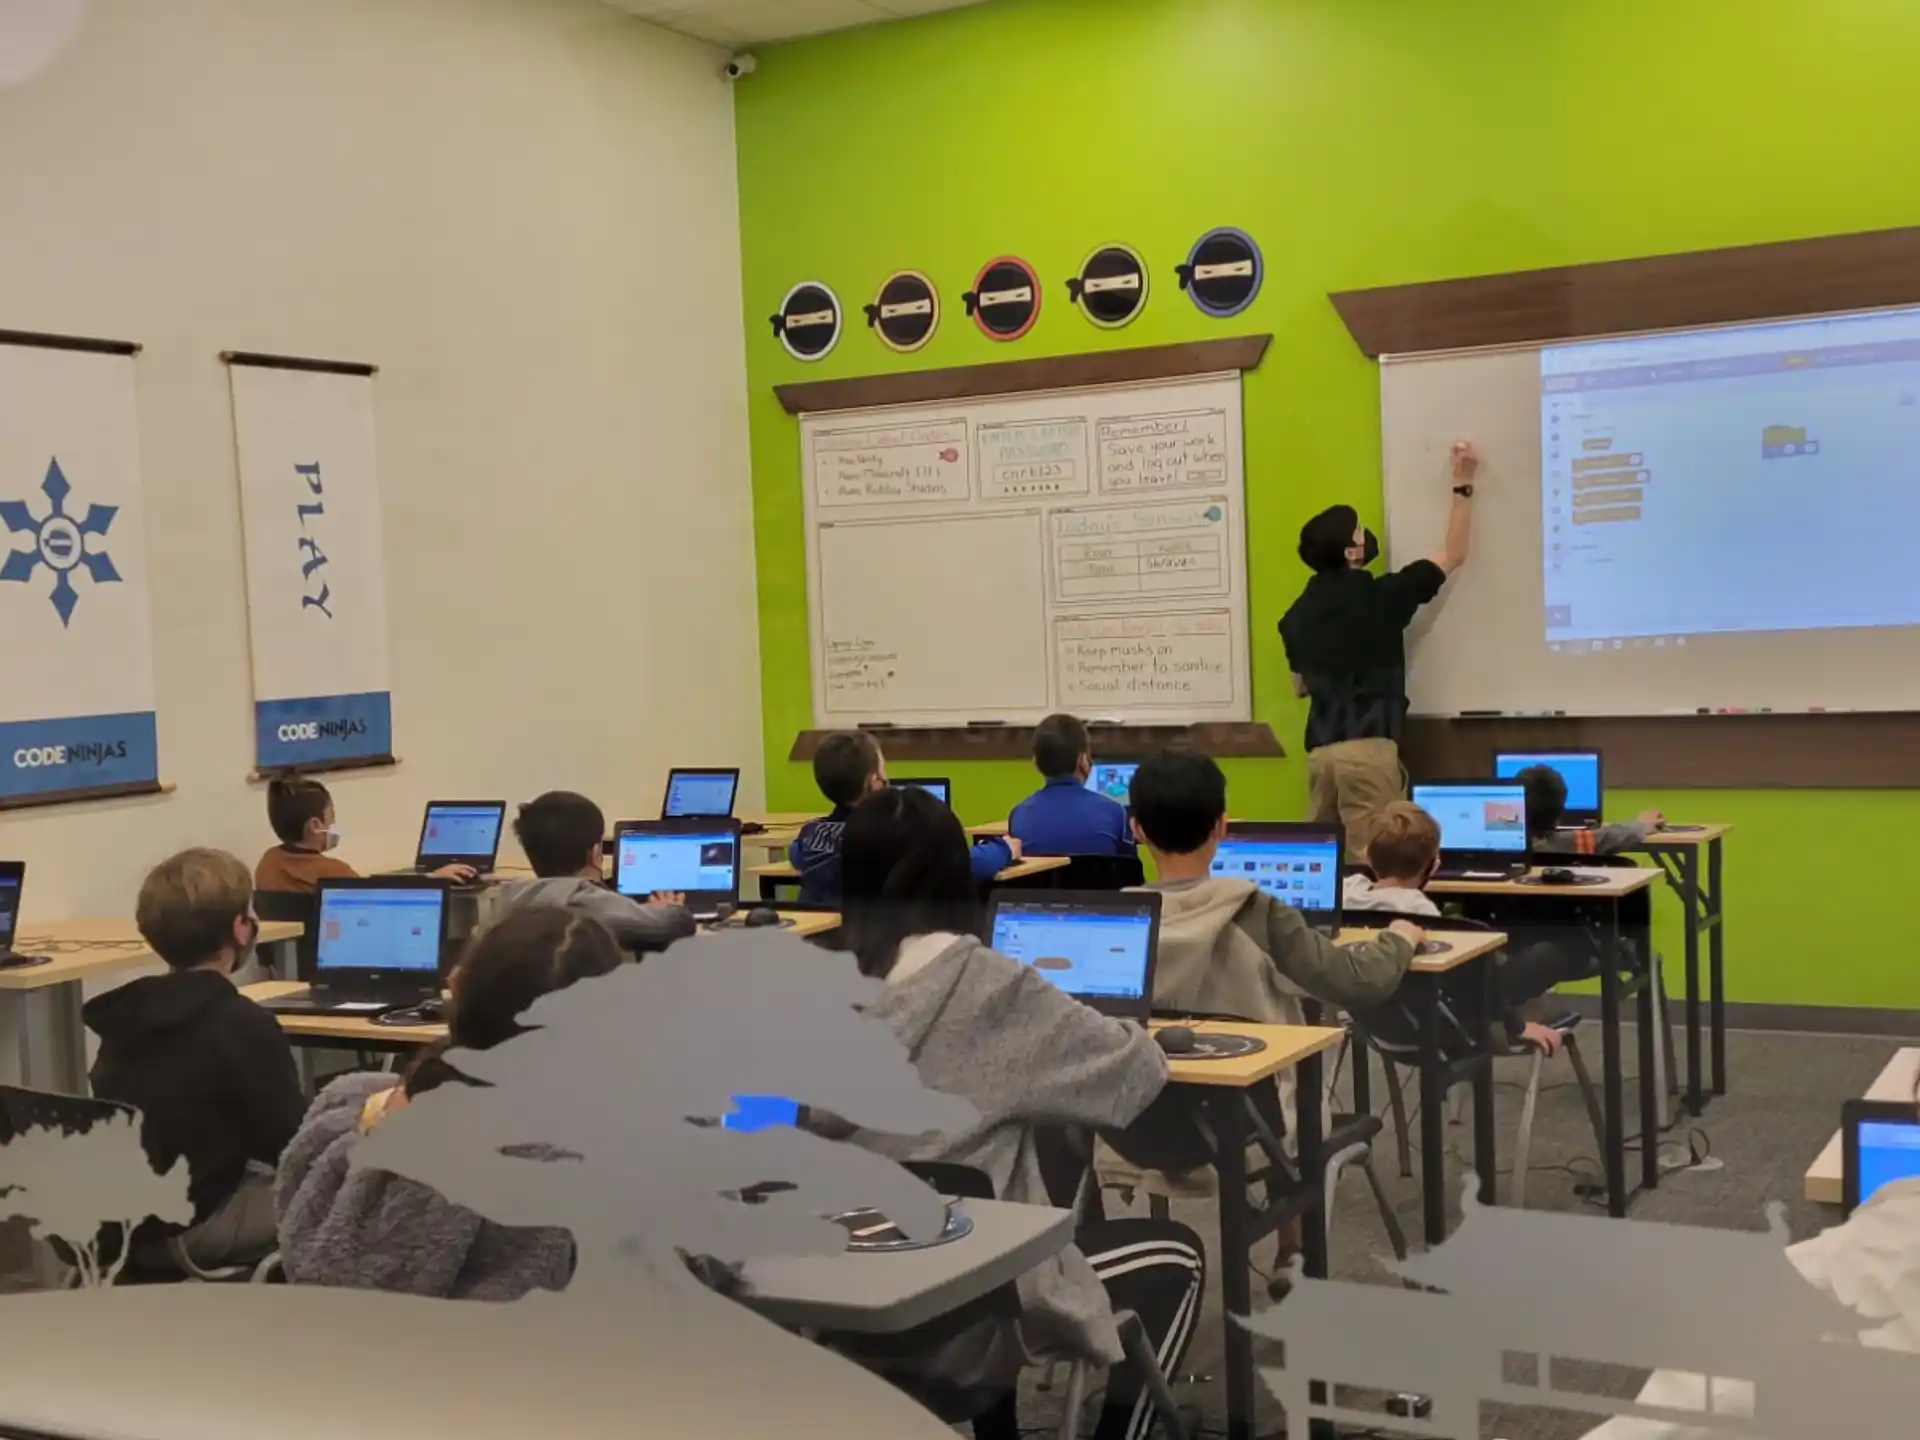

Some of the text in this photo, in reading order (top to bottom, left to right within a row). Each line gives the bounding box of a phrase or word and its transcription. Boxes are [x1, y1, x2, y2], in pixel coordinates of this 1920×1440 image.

[1107, 443, 1145, 456] Save
[1151, 440, 1176, 455] your
[1107, 460, 1135, 472] and
[1167, 452, 1187, 467] out
[1109, 475, 1132, 487] you
[294, 460, 333, 619] PLAY
[1077, 645, 1107, 659] Keep
[1156, 644, 1172, 655] on
[1078, 660, 1146, 674] Remember
[1153, 656, 1168, 676] to
[1078, 676, 1193, 693] Social distance
